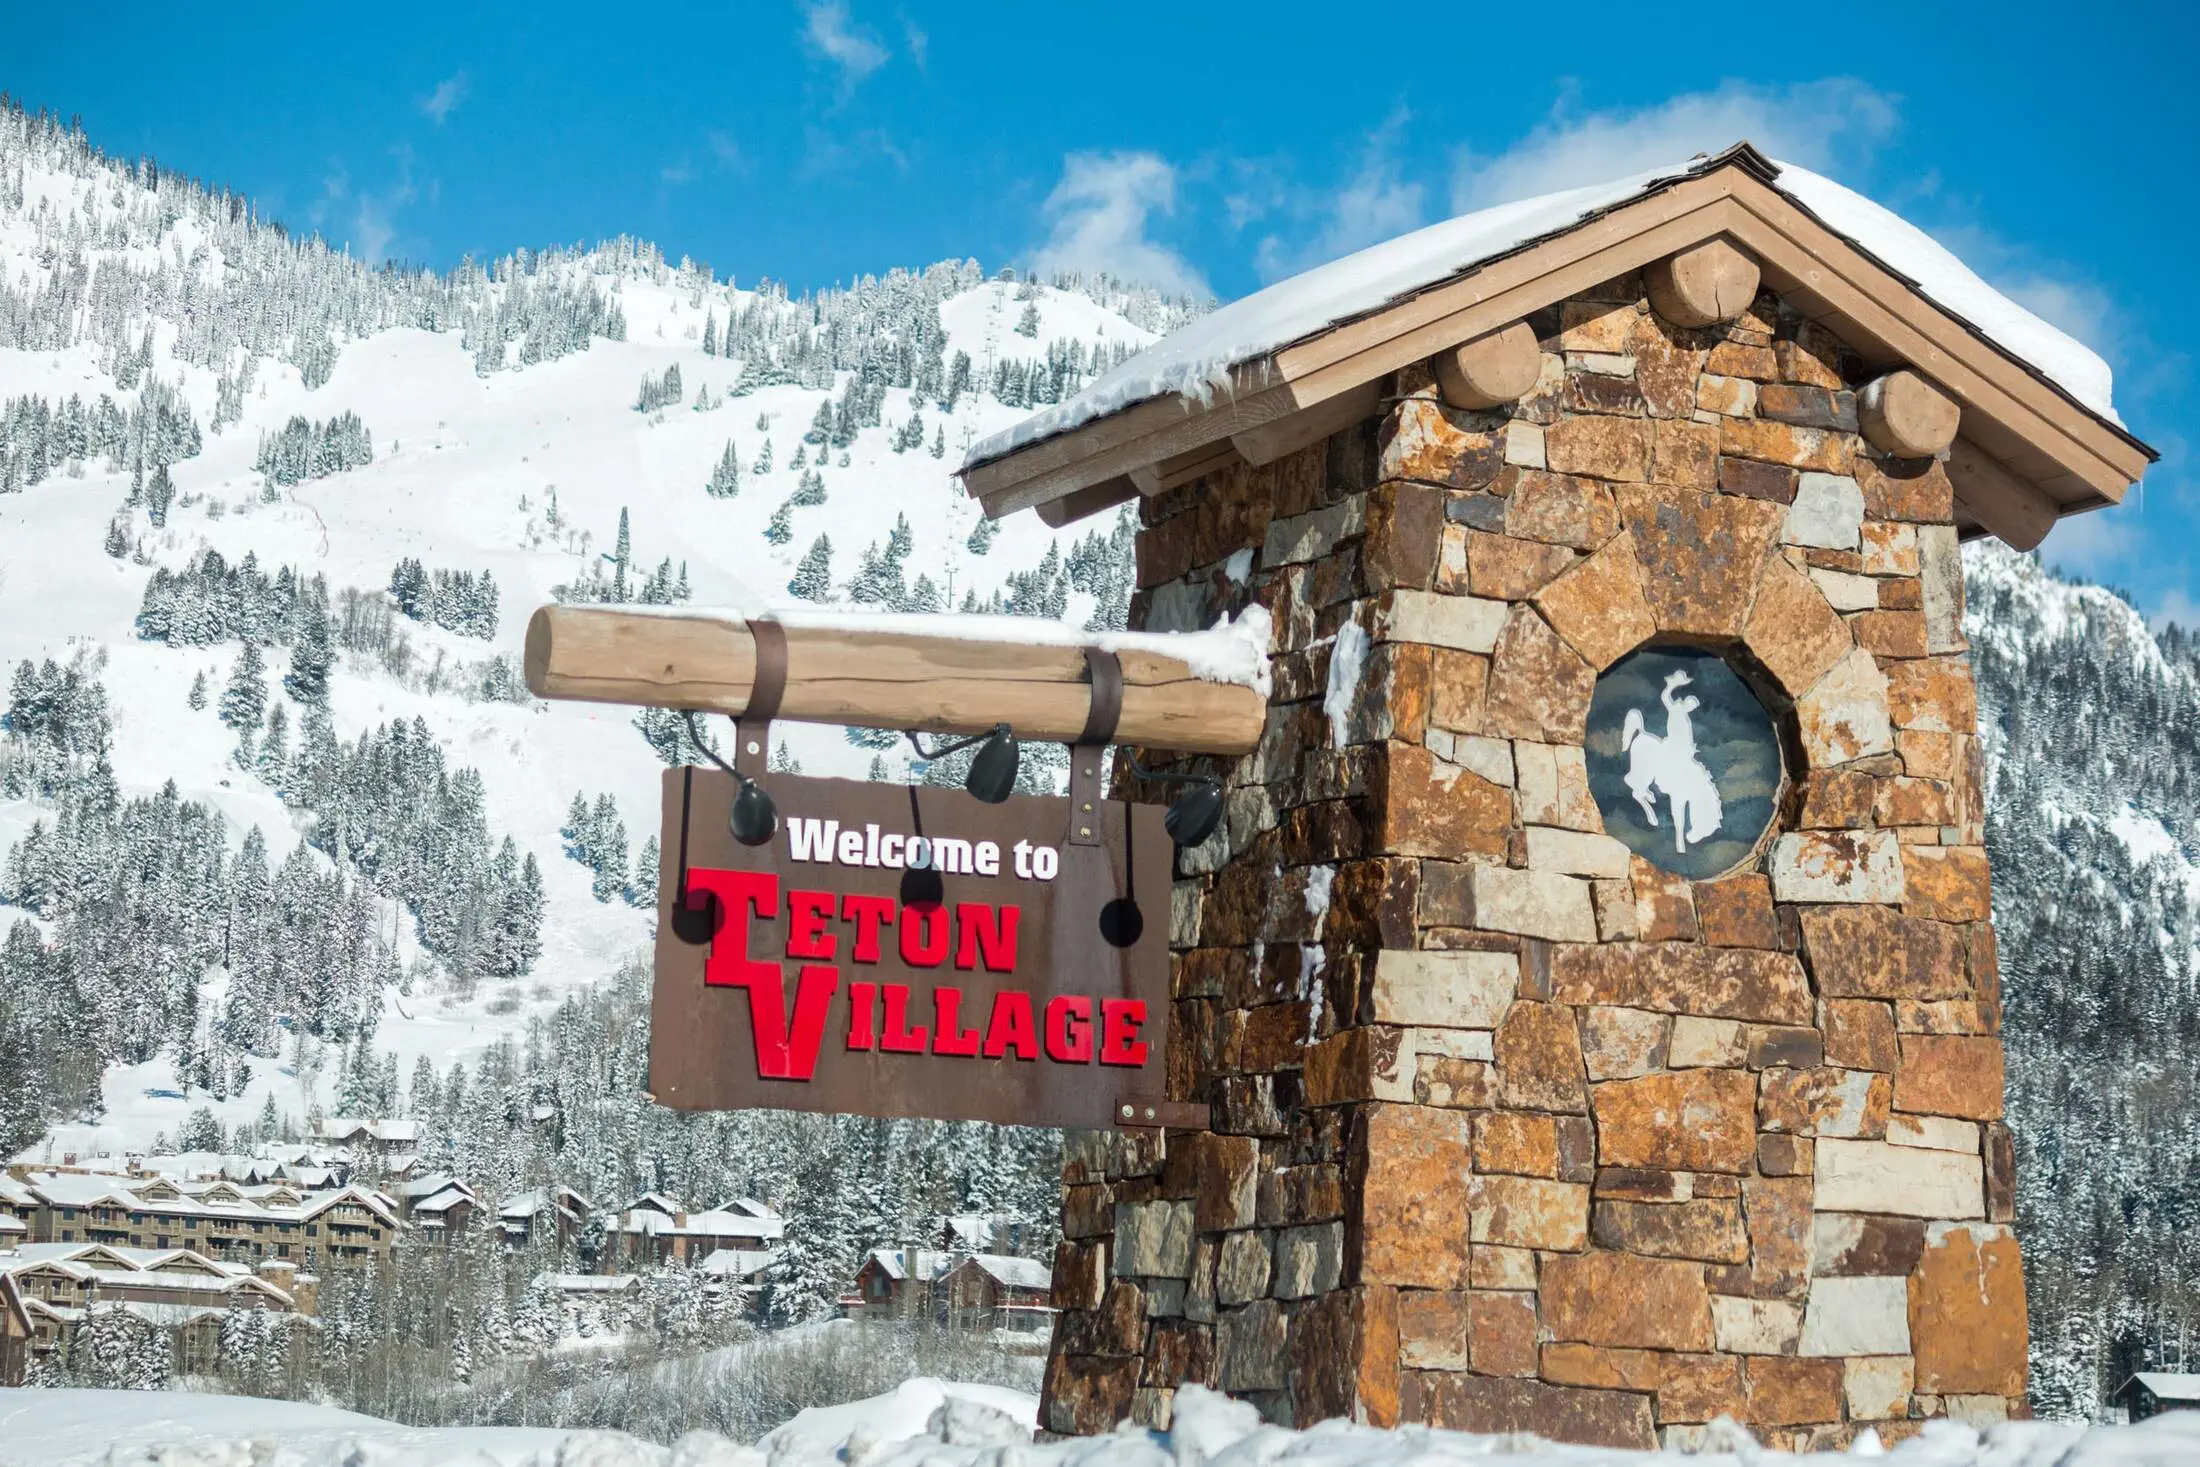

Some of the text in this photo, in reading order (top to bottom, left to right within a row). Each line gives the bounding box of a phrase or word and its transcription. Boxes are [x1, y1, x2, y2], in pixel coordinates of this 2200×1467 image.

[786, 817, 1059, 881] Welcome to
[686, 866, 1021, 986] TETON
[747, 961, 1148, 1080] VILLAGE
